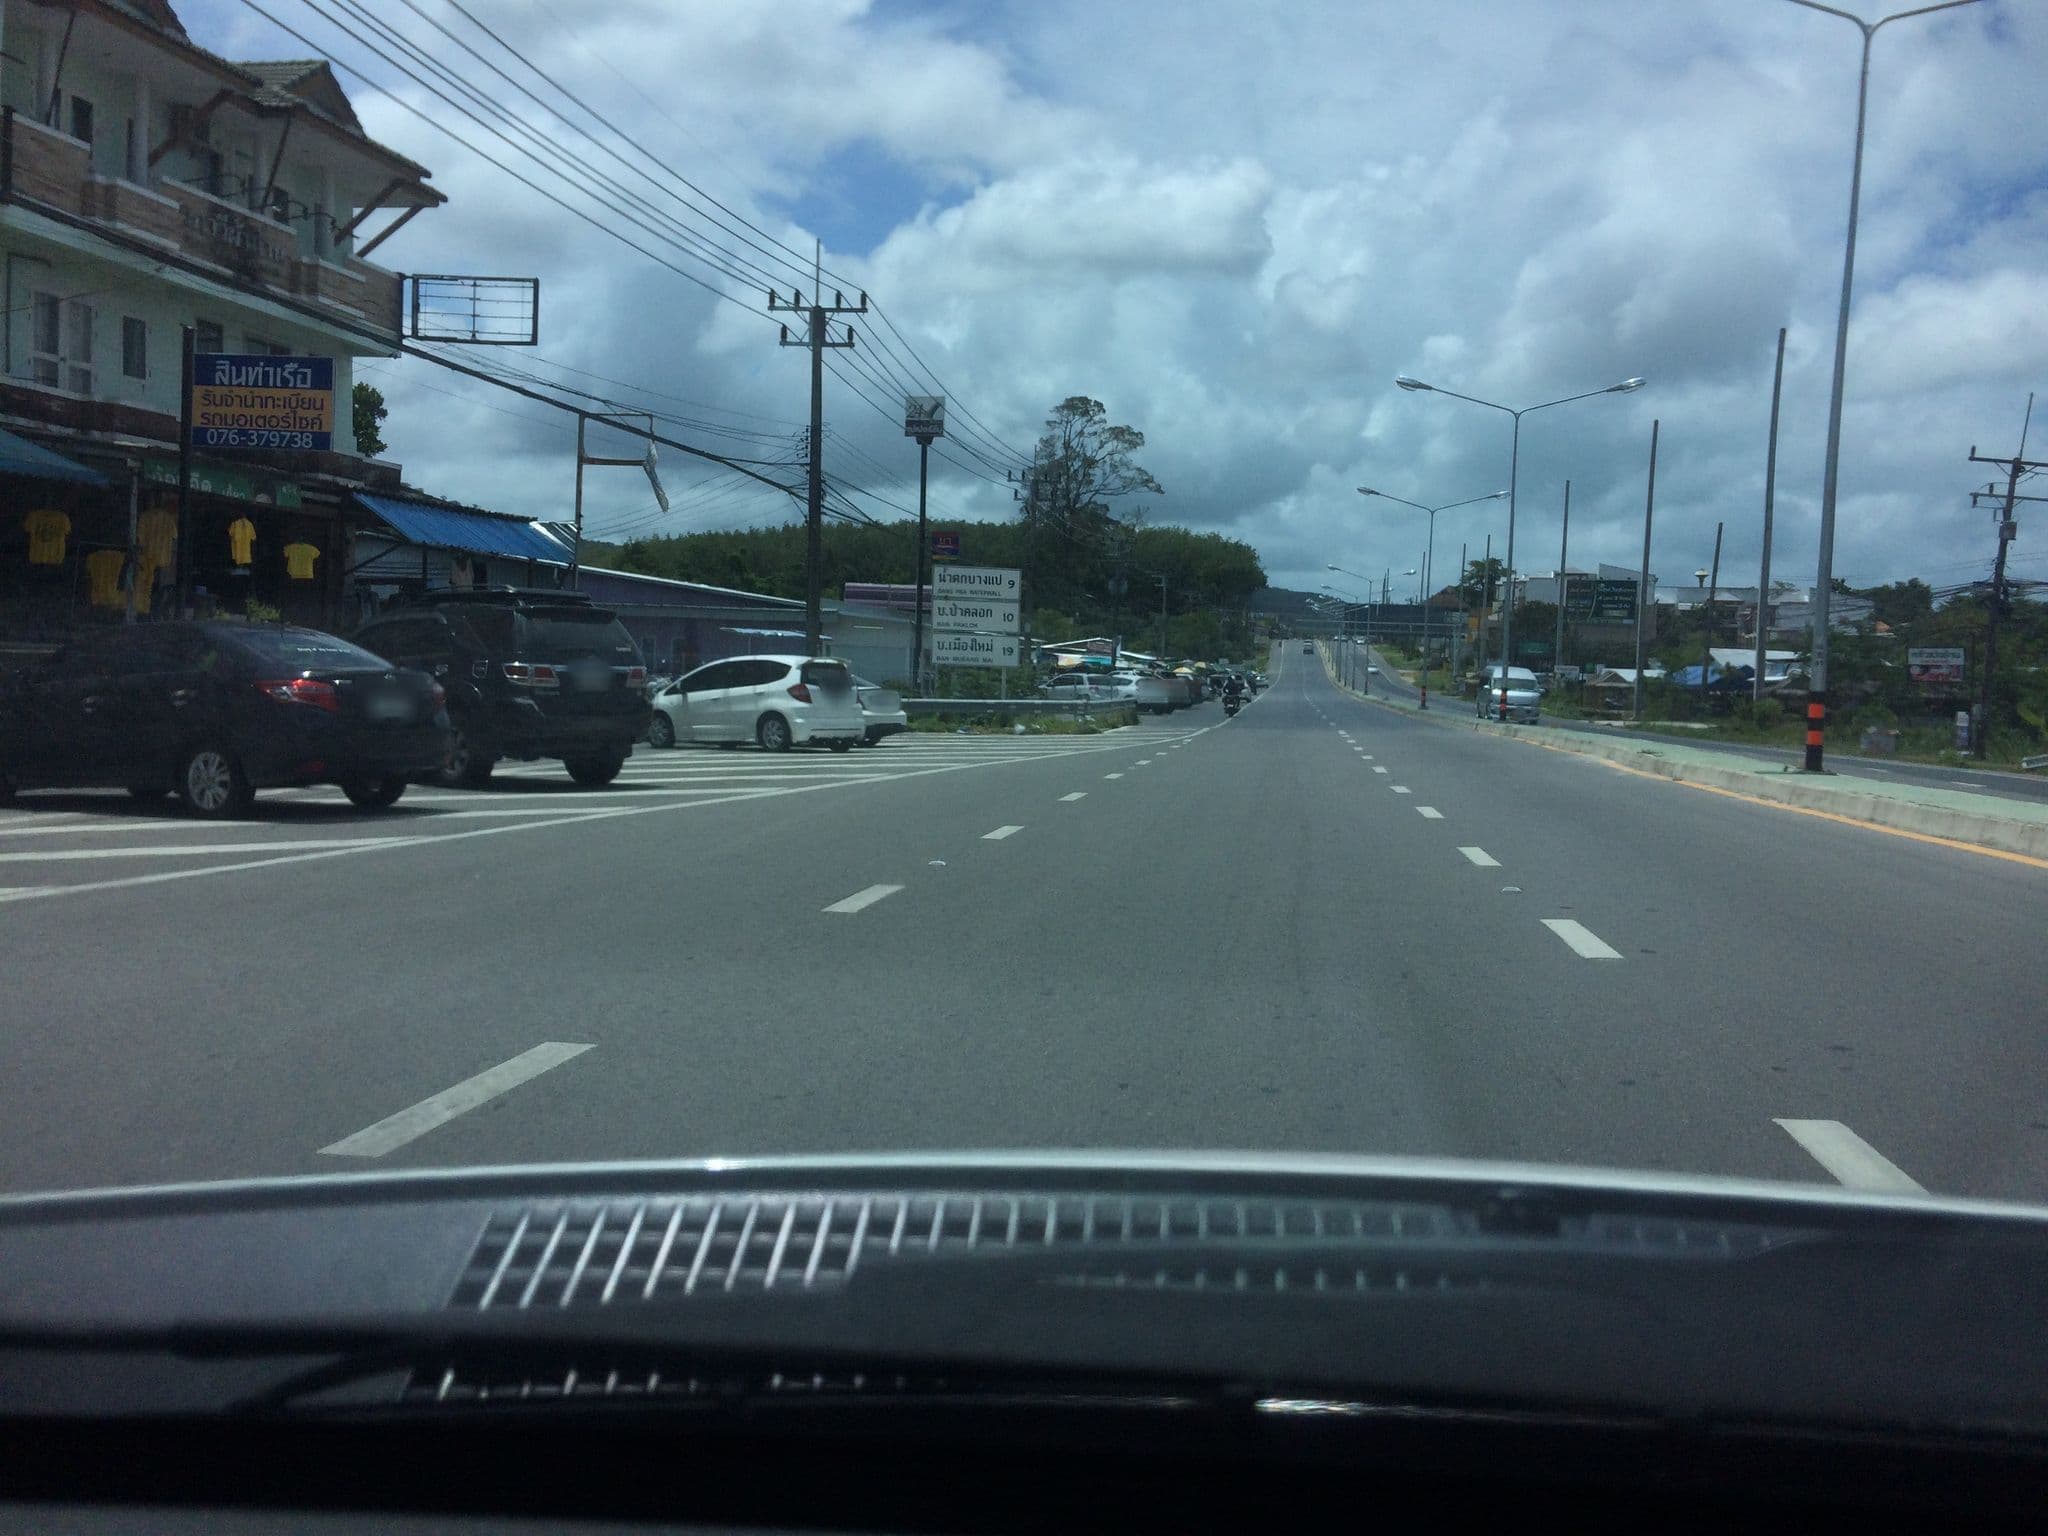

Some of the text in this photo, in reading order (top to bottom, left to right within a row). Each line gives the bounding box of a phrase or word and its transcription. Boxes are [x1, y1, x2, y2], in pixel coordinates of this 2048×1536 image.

[201, 389, 324, 411] รับจำนำทะเบียน
[206, 429, 313, 449] 076-379738
[1007, 579, 1016, 589] 9
[1003, 612, 1014, 623] 10
[937, 637, 1014, 656] บ.เมืองใหม่ 19
